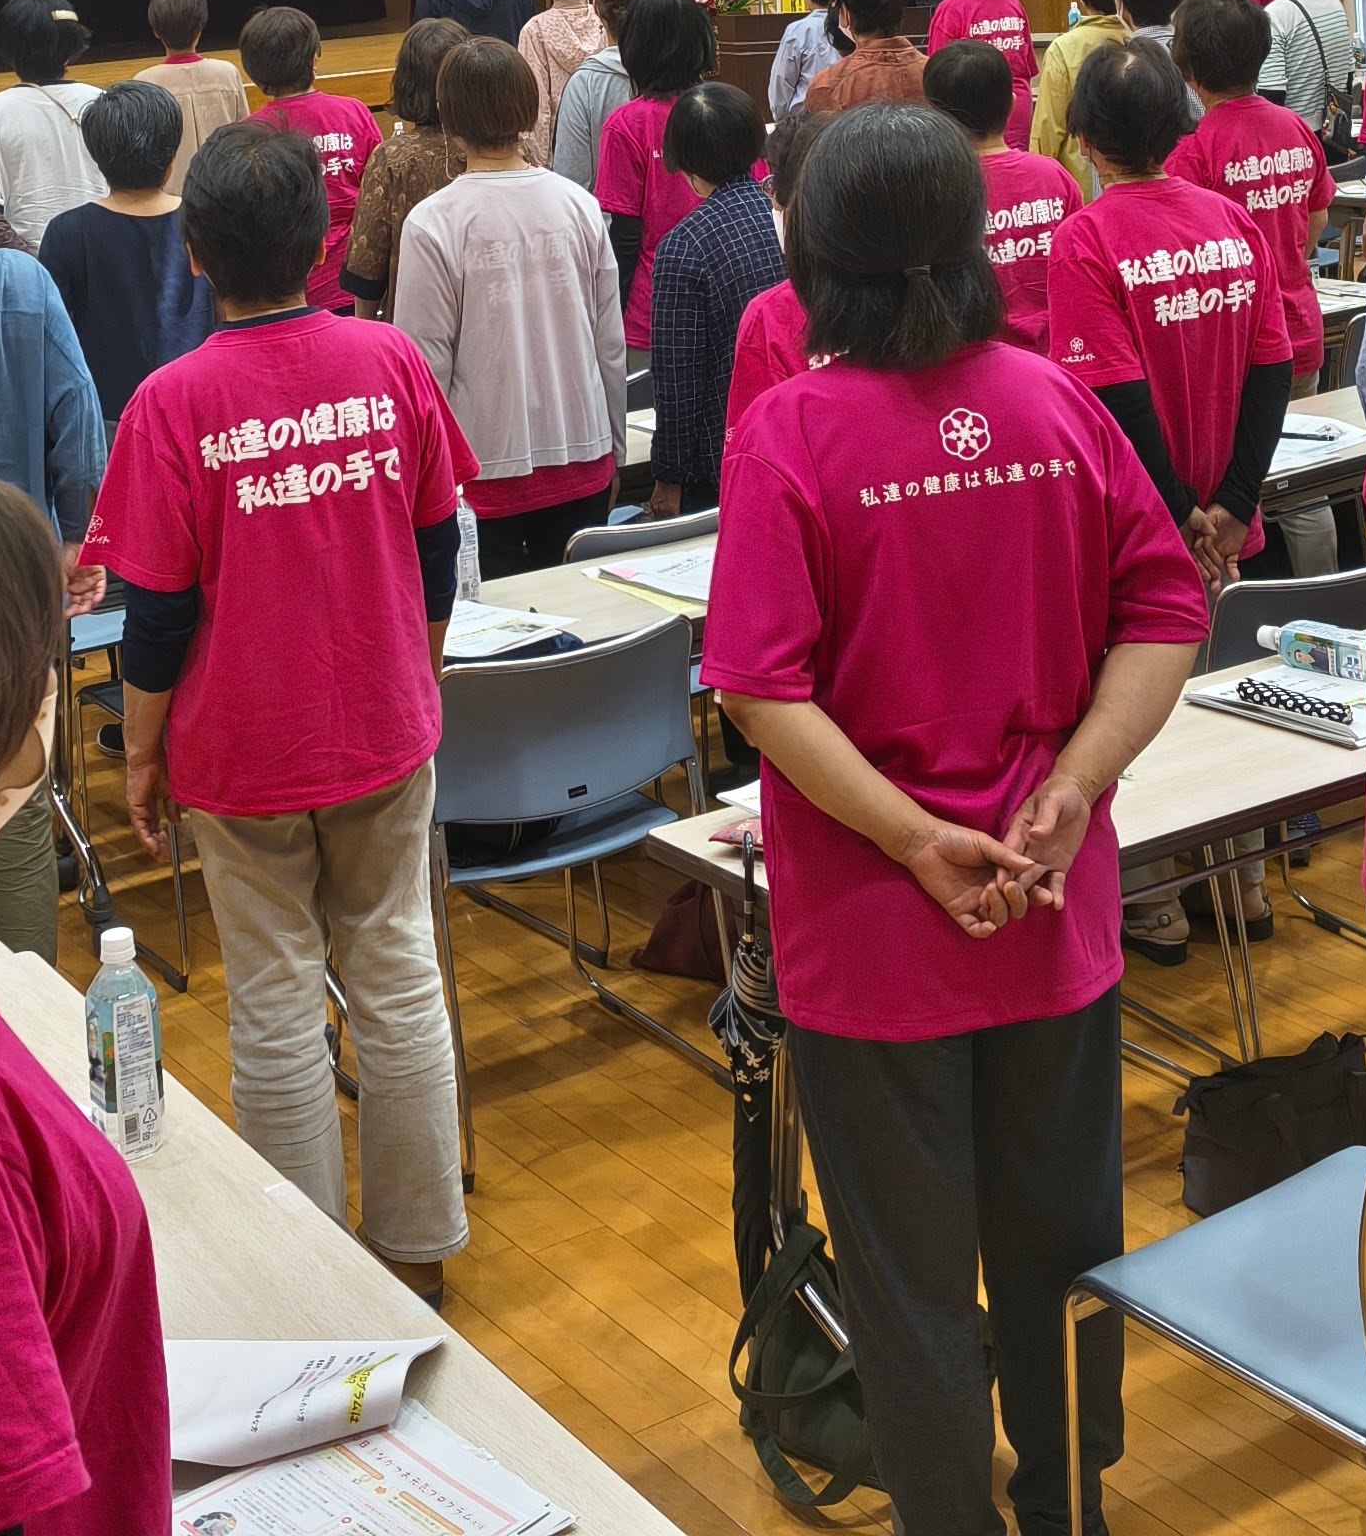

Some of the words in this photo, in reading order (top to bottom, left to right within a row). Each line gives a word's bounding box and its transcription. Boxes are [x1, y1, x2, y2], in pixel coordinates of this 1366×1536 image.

[1118, 238, 1254, 292] 私達の健康は
[199, 394, 397, 471] 私達の健康は
[236, 447, 401, 514] 私達の手で
[859, 459, 1077, 508] 私達の健康は私達の手で
